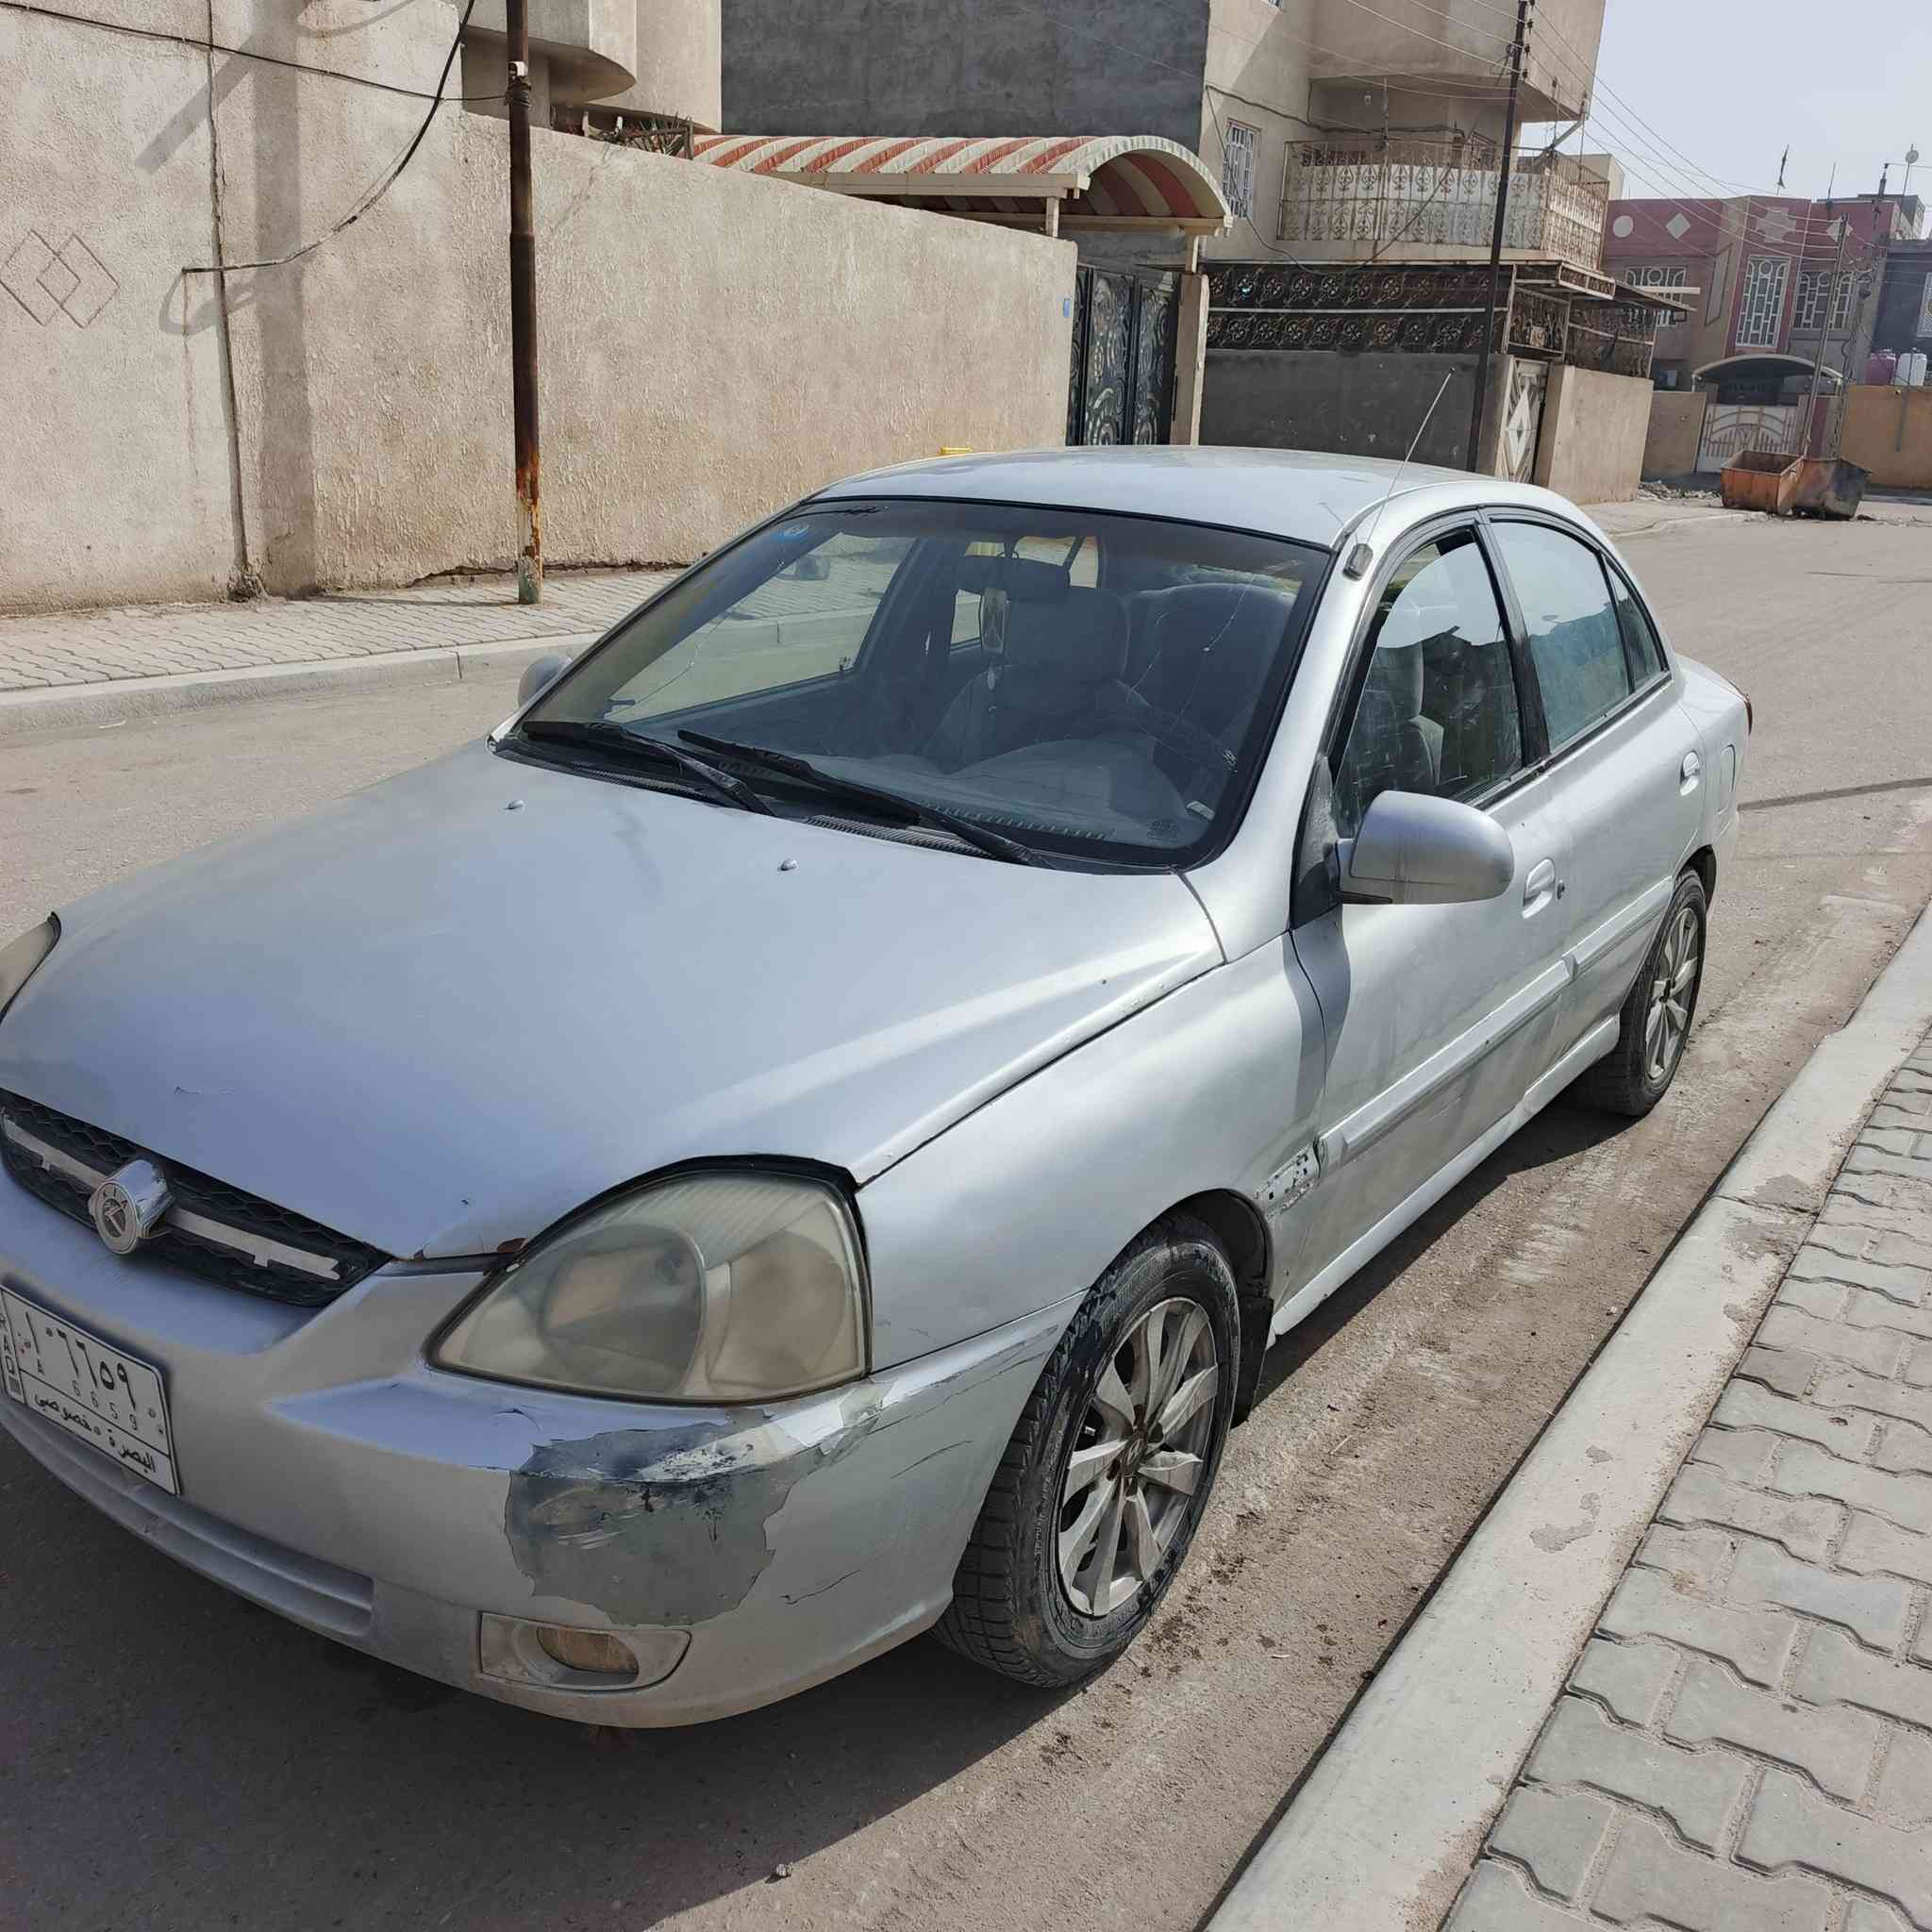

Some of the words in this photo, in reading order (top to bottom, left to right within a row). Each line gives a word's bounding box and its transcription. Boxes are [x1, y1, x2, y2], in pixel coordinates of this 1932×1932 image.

[0, 1312, 15, 1375] RAQ
[56, 1327, 136, 1411] ٦٦٥٩
[34, 1394, 92, 1432] خصوصي
[71, 1379, 139, 1431] 6659
[107, 1428, 157, 1474] البصرة
